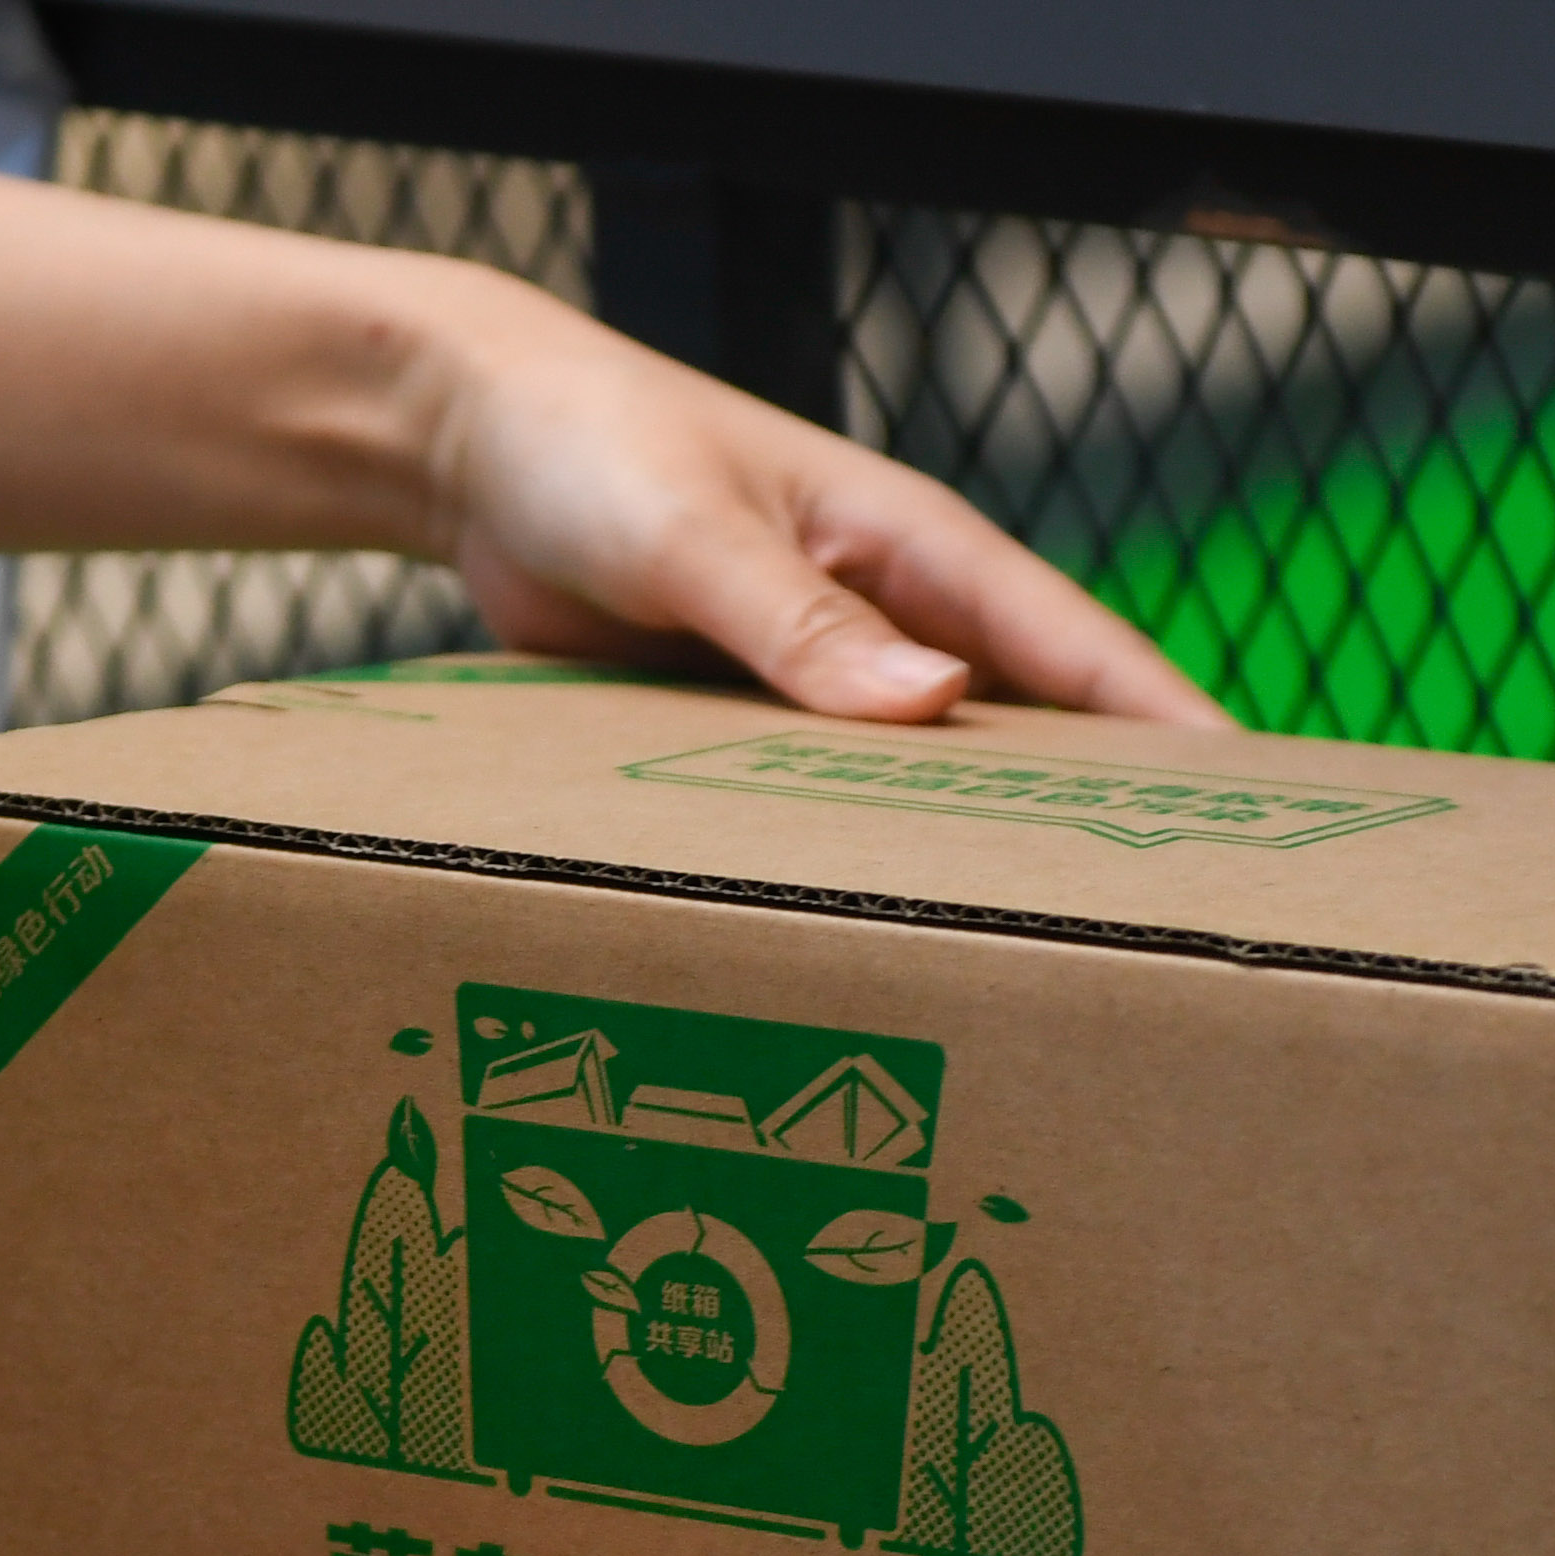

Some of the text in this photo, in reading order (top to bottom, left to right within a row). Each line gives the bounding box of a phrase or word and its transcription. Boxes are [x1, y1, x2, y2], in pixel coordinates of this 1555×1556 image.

[660, 1280, 721, 1319] 纸箱
[645, 1320, 735, 1364] 共享站
